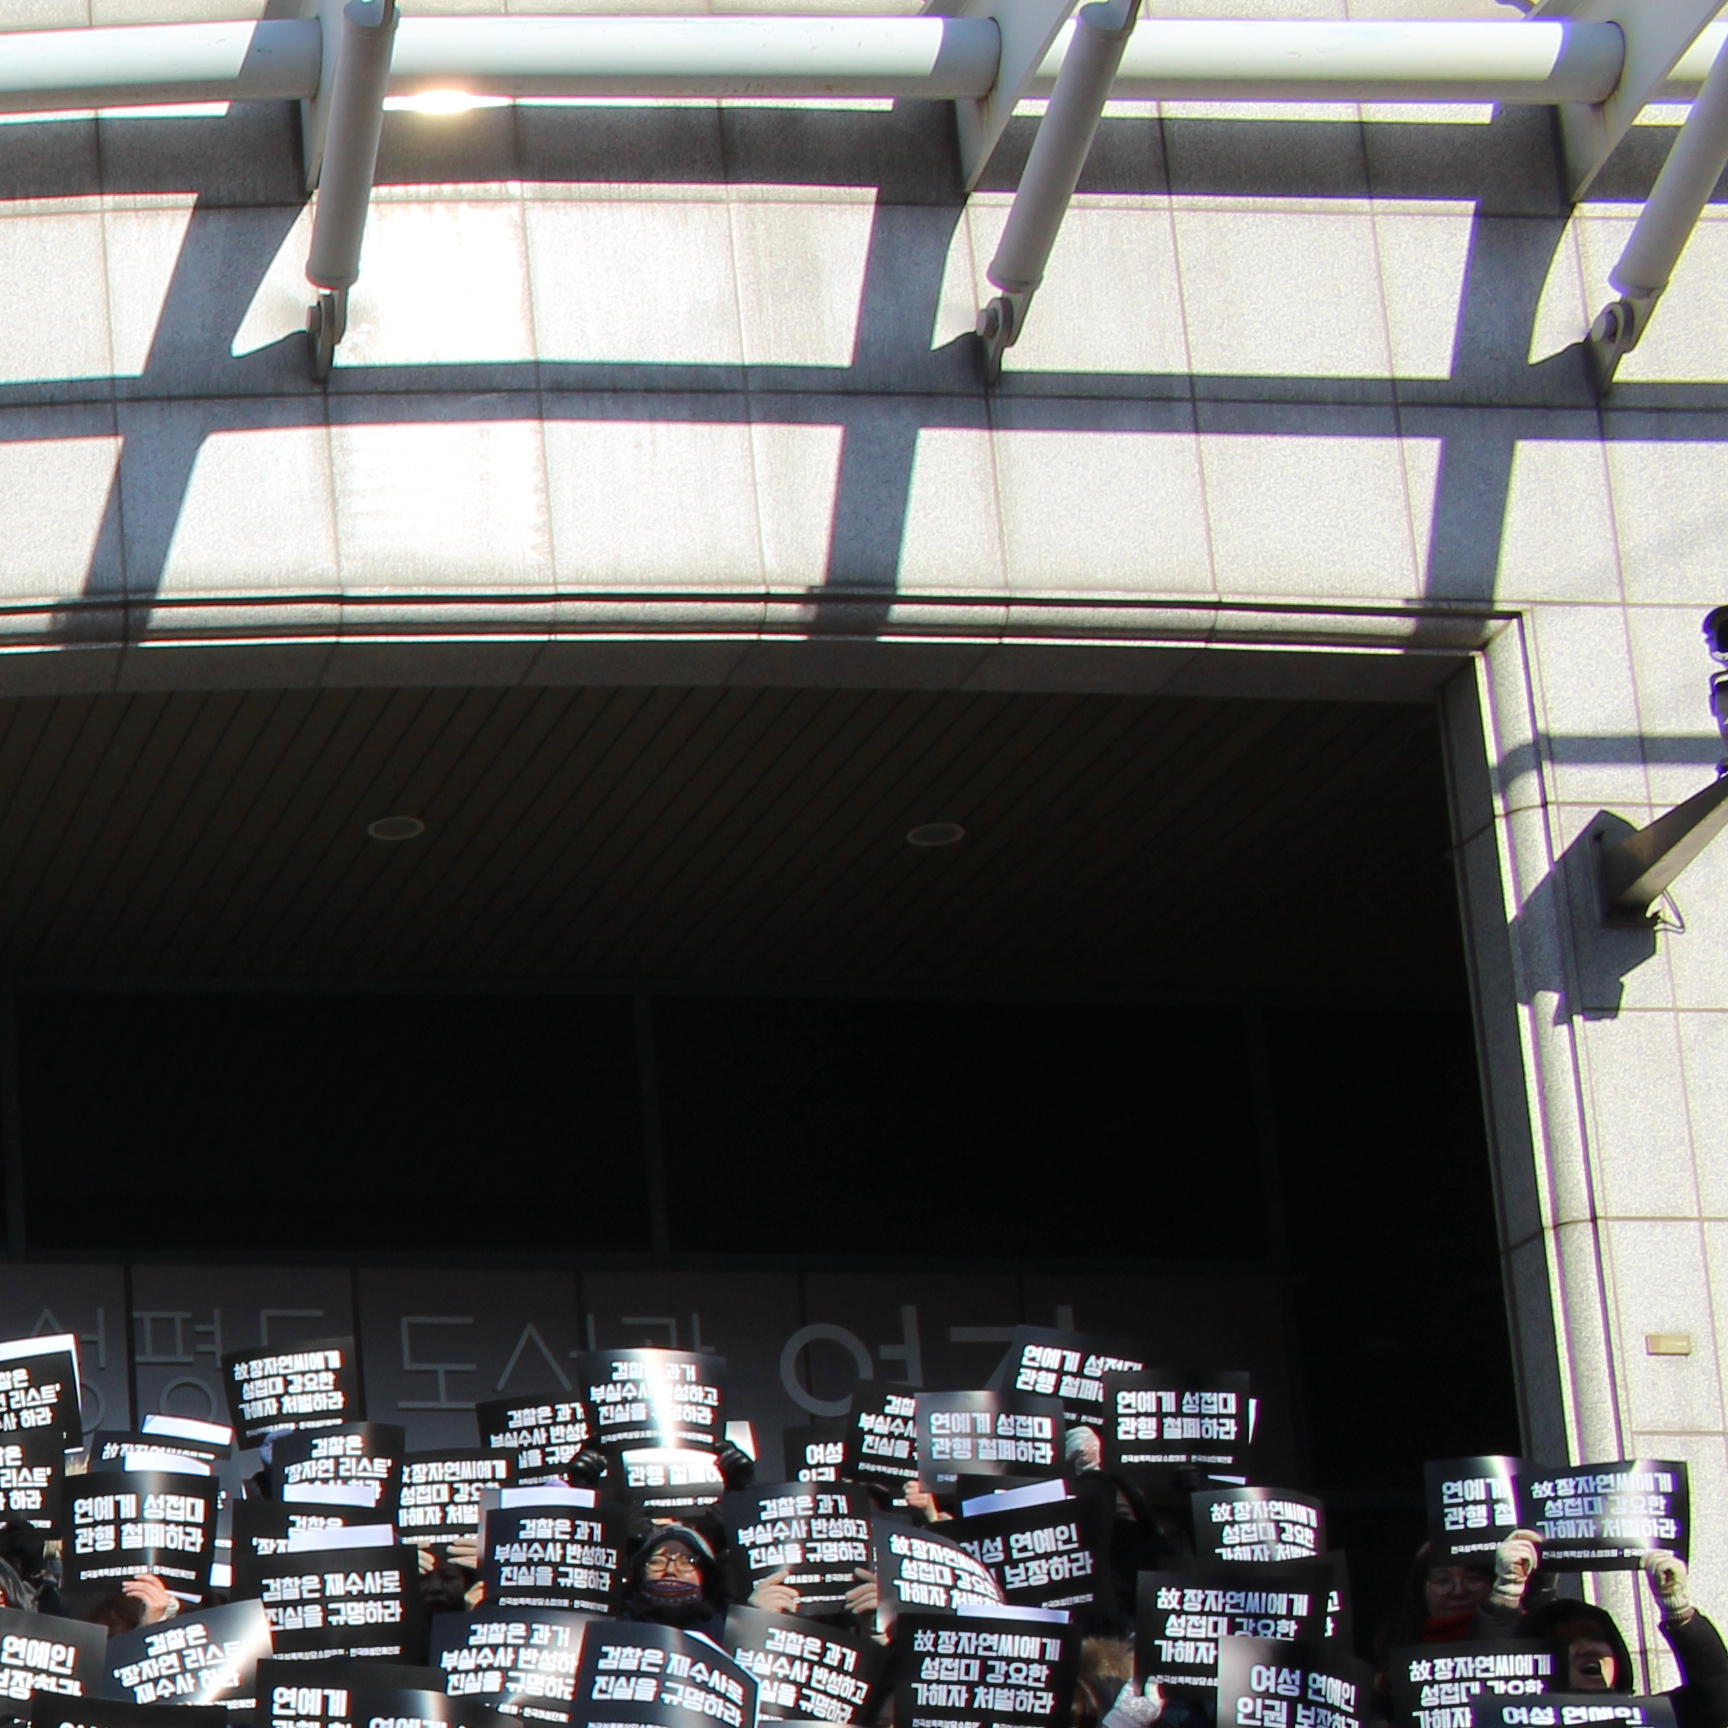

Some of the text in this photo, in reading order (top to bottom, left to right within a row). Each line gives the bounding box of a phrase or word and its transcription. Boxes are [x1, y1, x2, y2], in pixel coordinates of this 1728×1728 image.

[1117, 1392, 1237, 1414] 연예계 성접대
[1118, 1417, 1237, 1440] 관행 철폐하라
[1542, 1494, 1665, 1518] 성접대 강요한
[519, 1518, 601, 1542] 검찰은 과거
[1535, 1516, 1676, 1541] 가해자 처벌하라
[495, 1542, 616, 1569] 부실수사 반성하고
[501, 1566, 610, 1591] 진실을 규명하라
